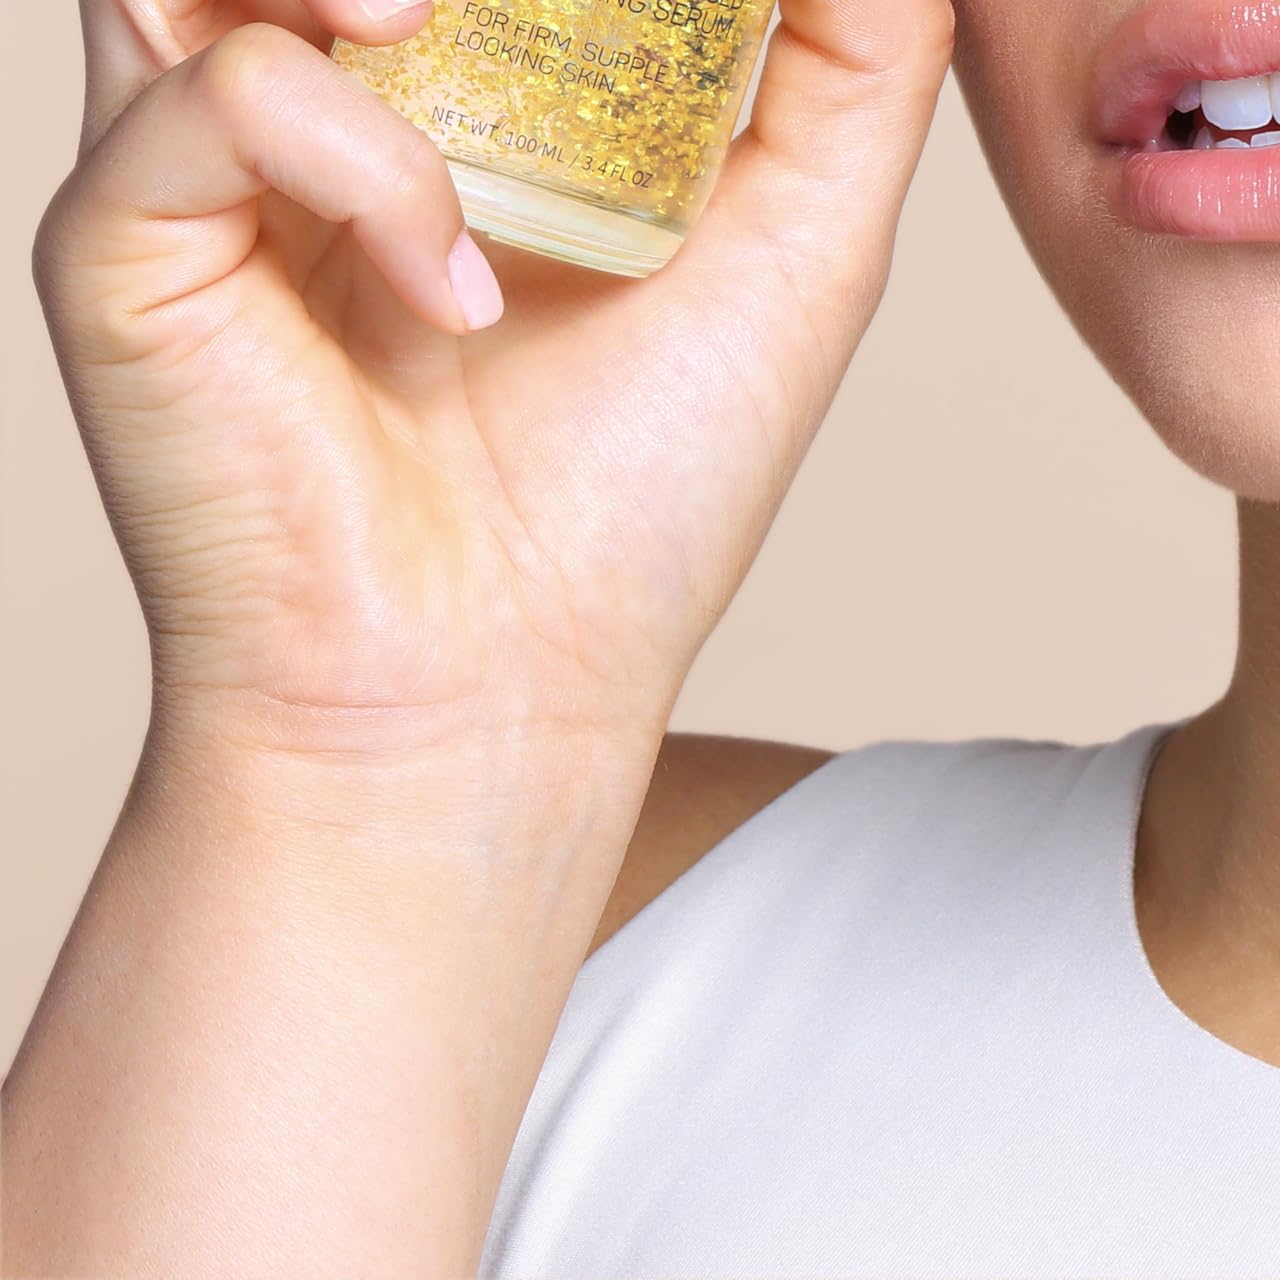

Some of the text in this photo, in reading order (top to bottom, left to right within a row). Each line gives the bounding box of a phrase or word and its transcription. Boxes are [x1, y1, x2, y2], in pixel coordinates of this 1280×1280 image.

[454, 25, 617, 95] LOOKING SKIN
[462, 1, 509, 33] FOR
[581, 42, 670, 84] SUPPLE
[431, 105, 468, 129] NET
[504, 131, 538, 153] 100
[541, 142, 566, 163] ML
[582, 155, 608, 176] 3.4
[610, 163, 627, 182] FL
[632, 170, 655, 189] OZ
